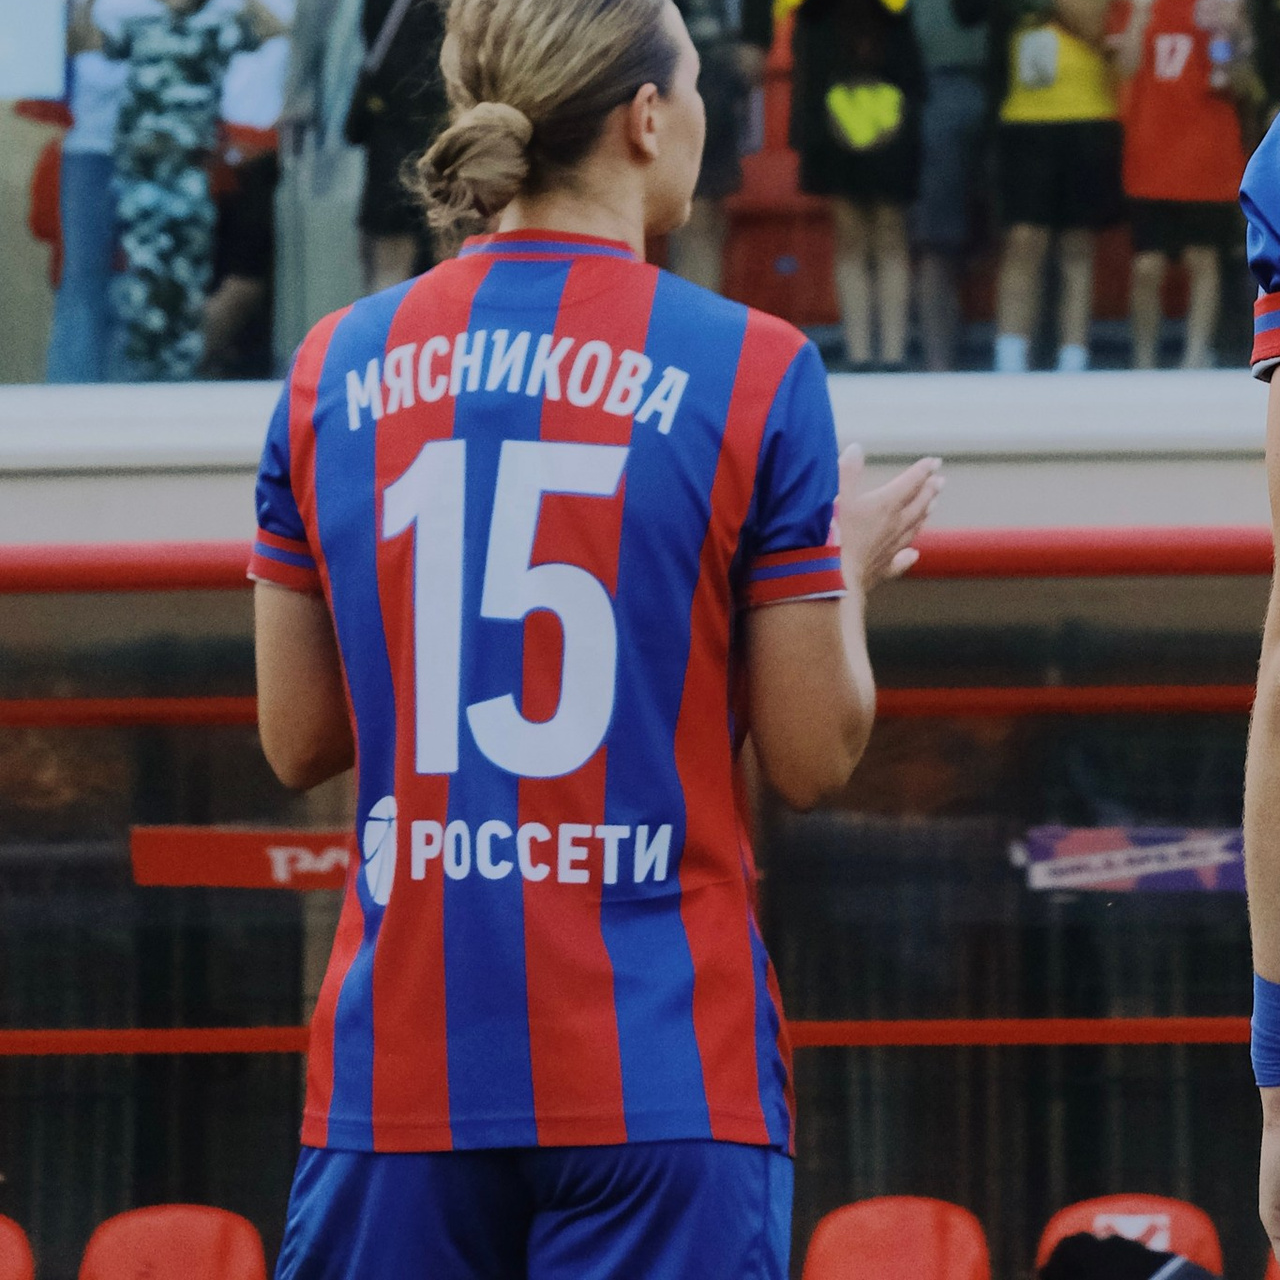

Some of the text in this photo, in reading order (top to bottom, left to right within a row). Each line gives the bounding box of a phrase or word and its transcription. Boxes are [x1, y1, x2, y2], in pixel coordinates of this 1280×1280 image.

[345, 328, 690, 435] МЯСНИКОВА
[381, 438, 631, 779] 15
[410, 819, 674, 884] РОССЕТИ
